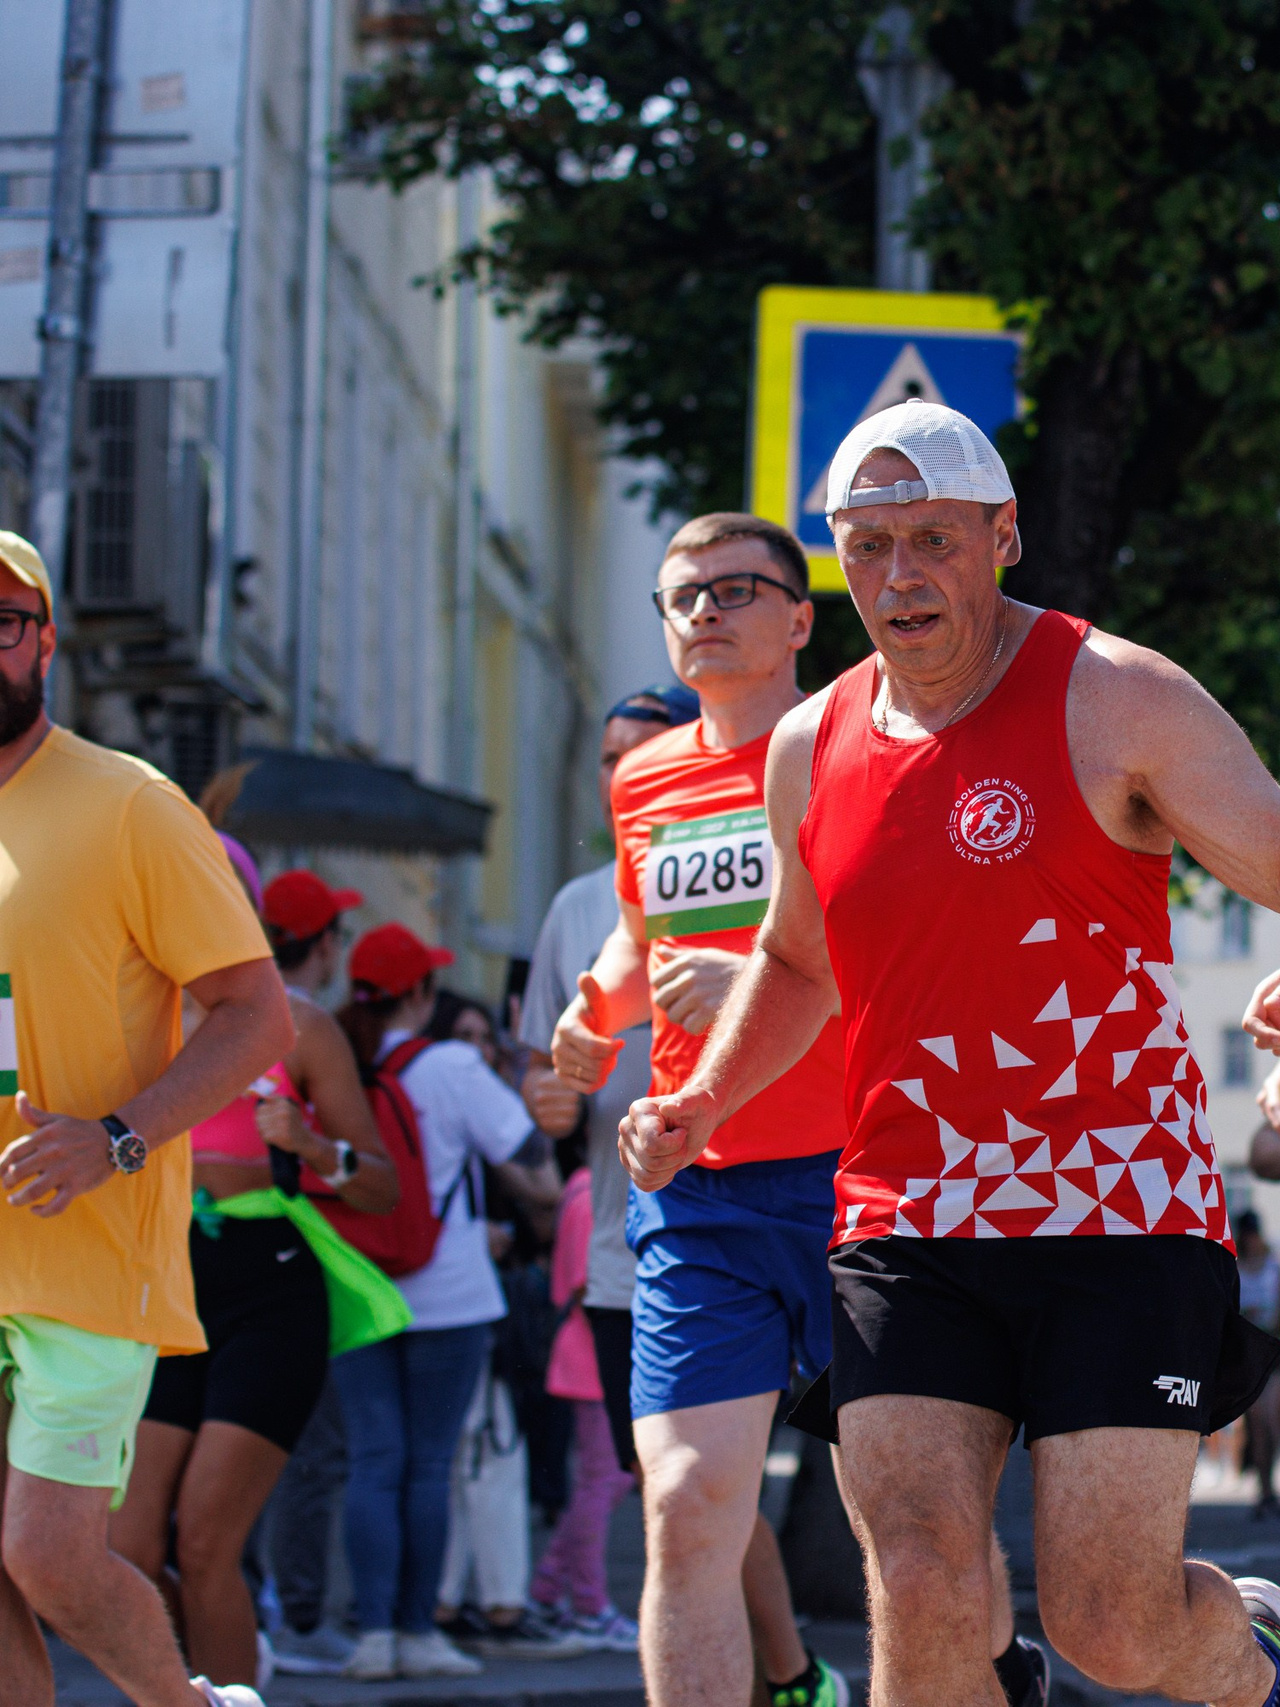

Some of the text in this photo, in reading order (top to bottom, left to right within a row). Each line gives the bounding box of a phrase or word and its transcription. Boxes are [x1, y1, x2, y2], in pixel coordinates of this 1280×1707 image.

[955, 778, 1029, 808] GOLDEN RING
[955, 840, 1031, 865] ULTRA TRAIL
[657, 841, 764, 901] 0285
[1153, 1375, 1201, 1407] RAY
